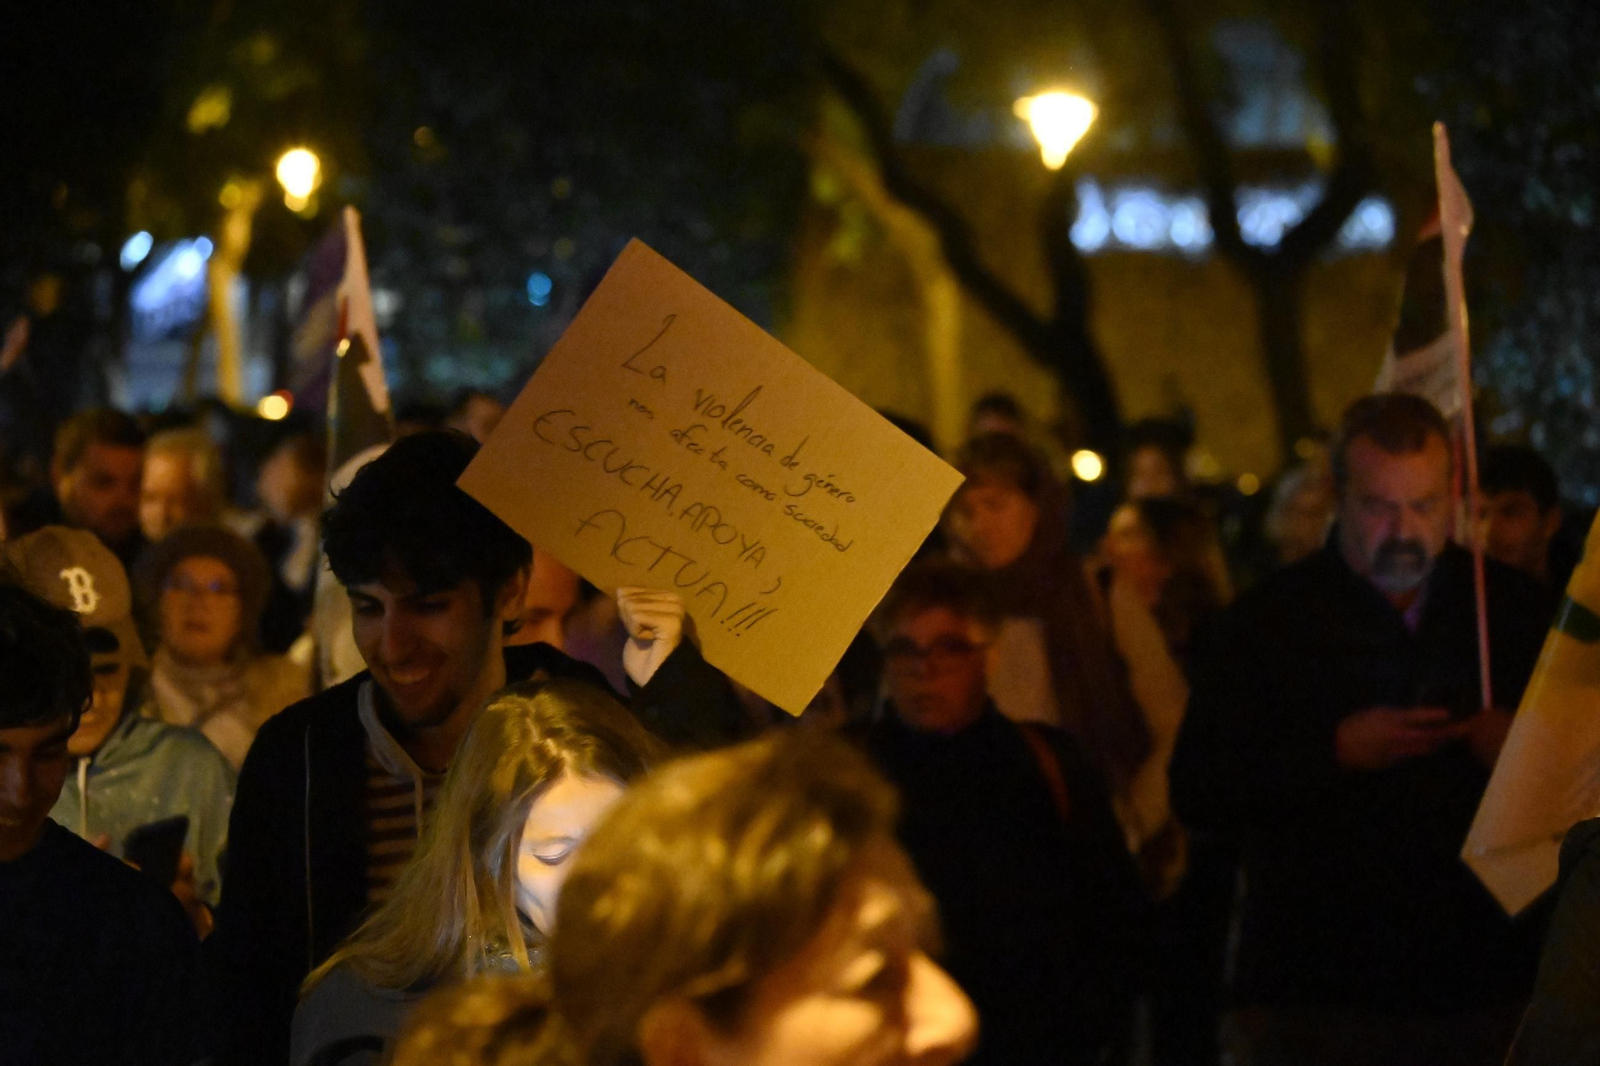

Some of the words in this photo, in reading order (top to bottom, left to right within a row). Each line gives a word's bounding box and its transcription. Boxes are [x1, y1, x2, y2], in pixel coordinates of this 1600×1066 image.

[622, 313, 677, 384] La
[693, 385, 775, 457] violencia
[779, 434, 810, 471] de
[59, 566, 98, 615] B
